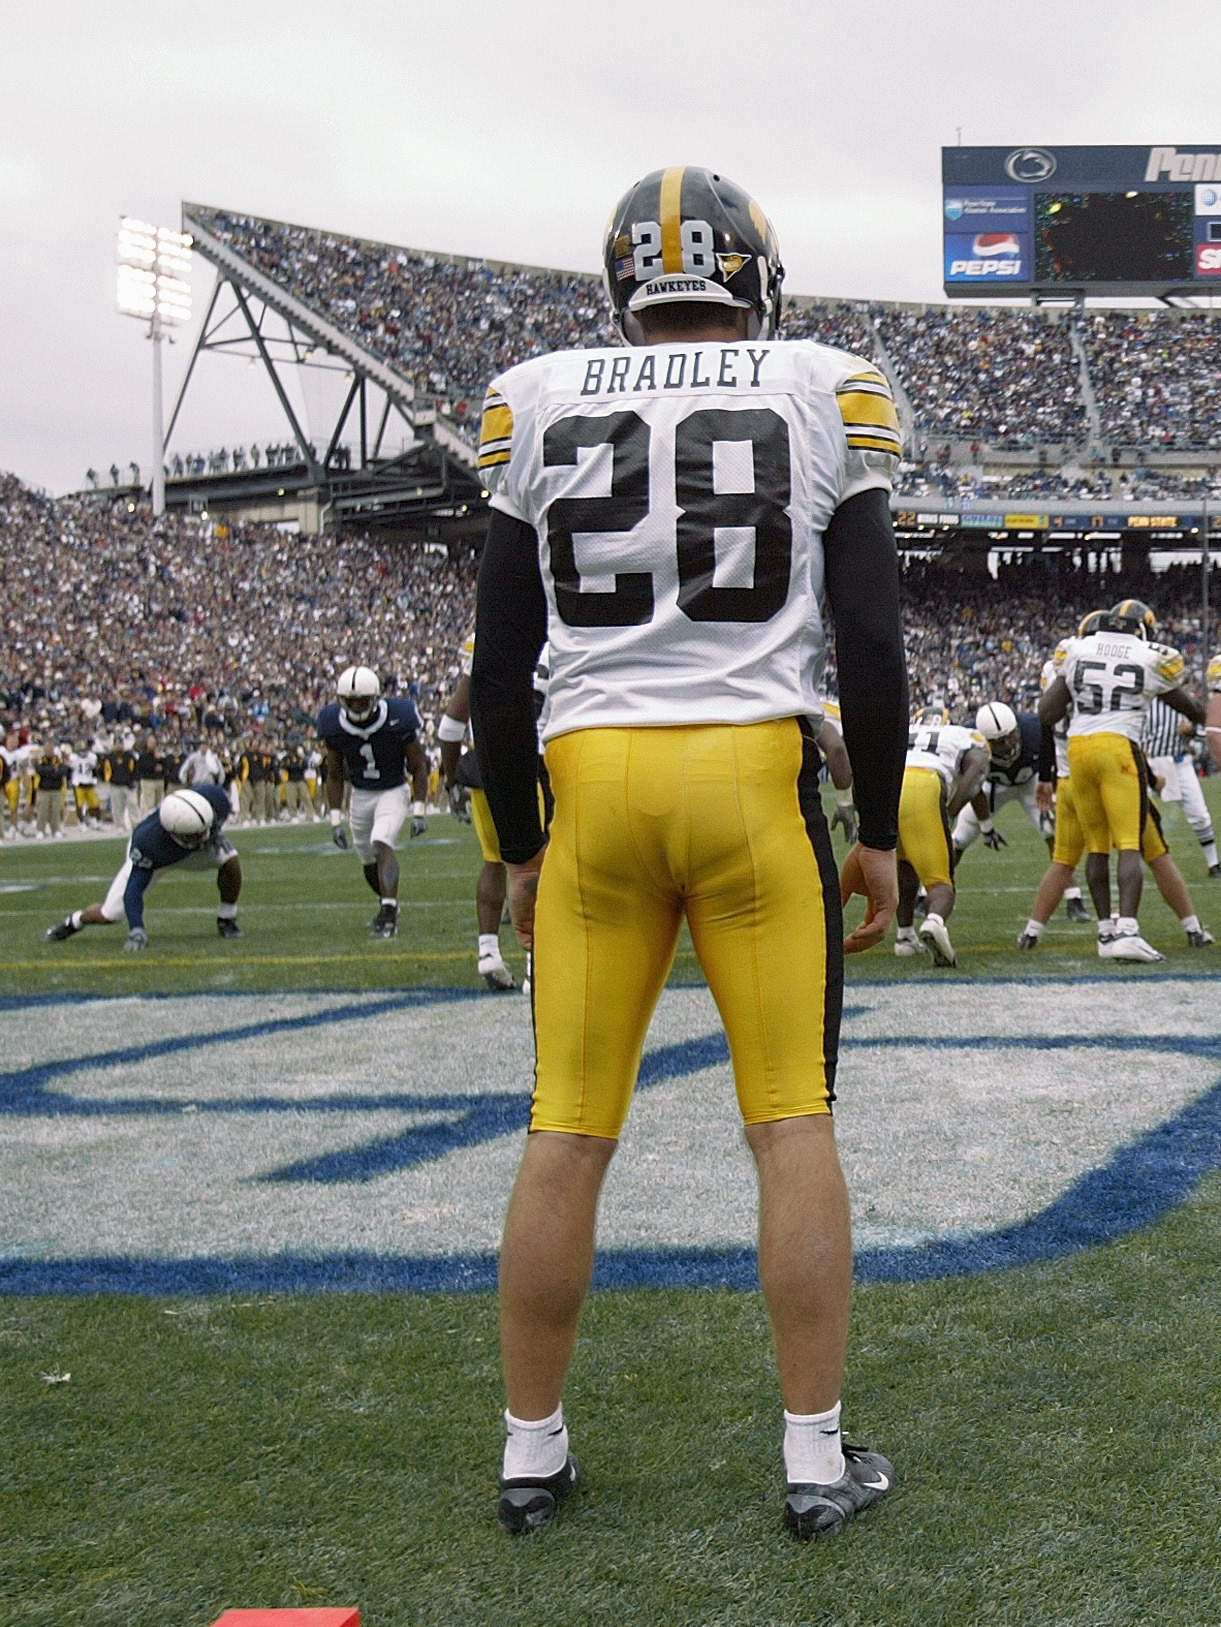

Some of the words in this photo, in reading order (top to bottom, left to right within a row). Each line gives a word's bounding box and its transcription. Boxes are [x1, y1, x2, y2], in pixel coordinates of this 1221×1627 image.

[950, 260, 1022, 277] PEPSI
[646, 280, 707, 296] HAWKEYES
[580, 349, 770, 396] BRADLEY
[543, 408, 793, 627] 28
[1096, 643, 1132, 659] HODGE
[1073, 659, 1145, 714] 52
[359, 743, 381, 780] 1
